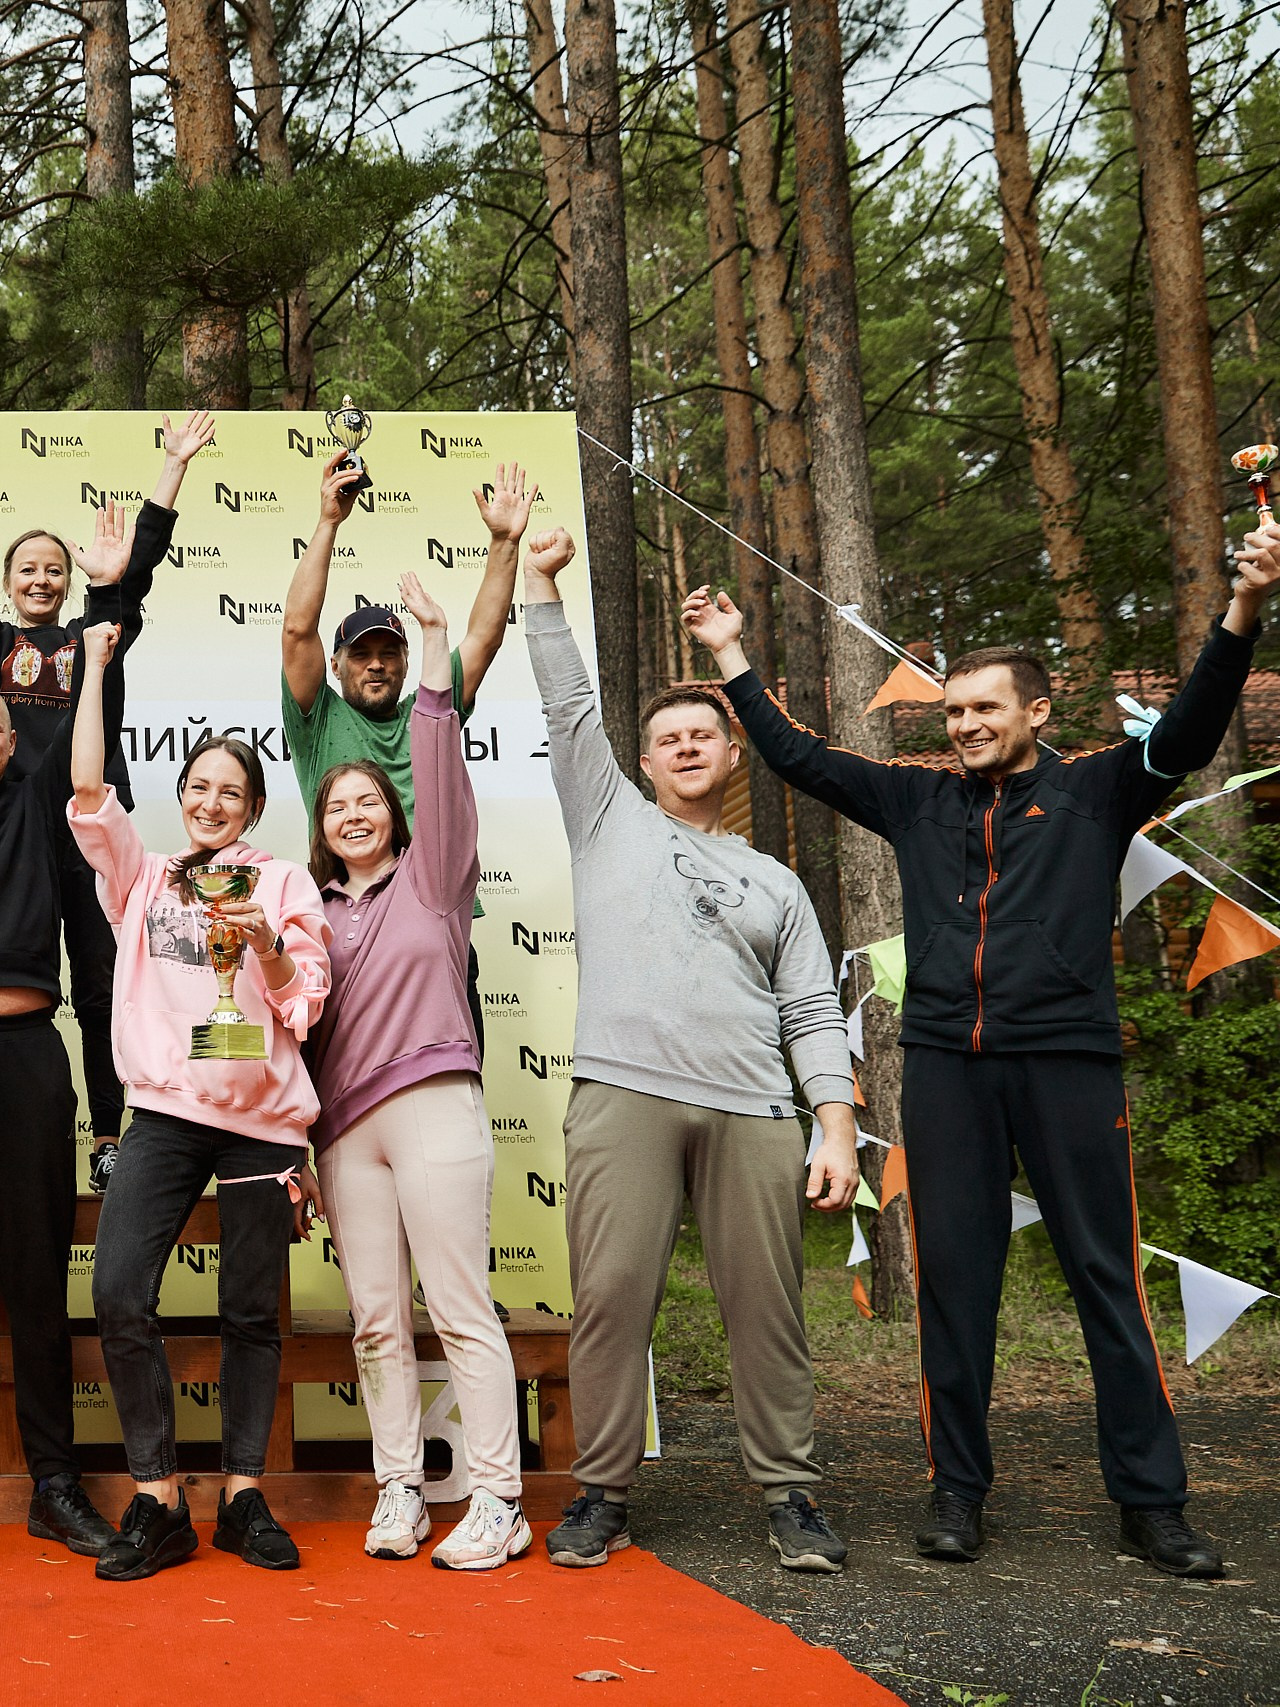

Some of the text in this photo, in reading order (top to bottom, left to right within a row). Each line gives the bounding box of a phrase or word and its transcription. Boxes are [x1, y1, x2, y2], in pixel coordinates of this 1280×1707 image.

[49, 436, 84, 447] NIKA
[316, 437, 342, 447] NIK
[449, 437, 483, 447] NIKA
[49, 450, 90, 458] PetroTech
[194, 450, 224, 458] roTech
[450, 450, 490, 459] PetroTech
[110, 490, 144, 501] NIKA
[244, 491, 278, 502] NIKA
[377, 491, 411, 502] NIKA
[244, 505, 284, 513] PetroTech
[378, 505, 419, 513] PetroTech
[529, 505, 552, 513] oTech
[187, 546, 221, 557] NIKA
[332, 547, 356, 558] IKA
[456, 547, 489, 558] NIKA
[187, 560, 228, 569] PetroTech
[328, 560, 363, 569] etroTech
[457, 560, 487, 569] PetroTe
[248, 603, 283, 613] NIKA
[384, 603, 412, 613] NIK
[248, 617, 283, 625] PetroTec
[11, 693, 33, 706] glory
[34, 695, 56, 707] from
[478, 871, 513, 883] NIKA
[478, 885, 520, 895] PetroTech
[542, 931, 576, 943] NIKA
[543, 945, 576, 956] PetroTe
[484, 993, 520, 1005] NIKA
[485, 1007, 528, 1018] PetroTech
[550, 1055, 575, 1067] NIK
[491, 1118, 528, 1131] NIKA
[491, 1133, 536, 1144] PetroTech
[499, 1247, 537, 1259] NIKA
[68, 1265, 94, 1276] etroTe
[499, 1262, 545, 1273] PetroTech
[73, 1382, 102, 1395] IKA
[72, 1398, 109, 1409] etroTech
